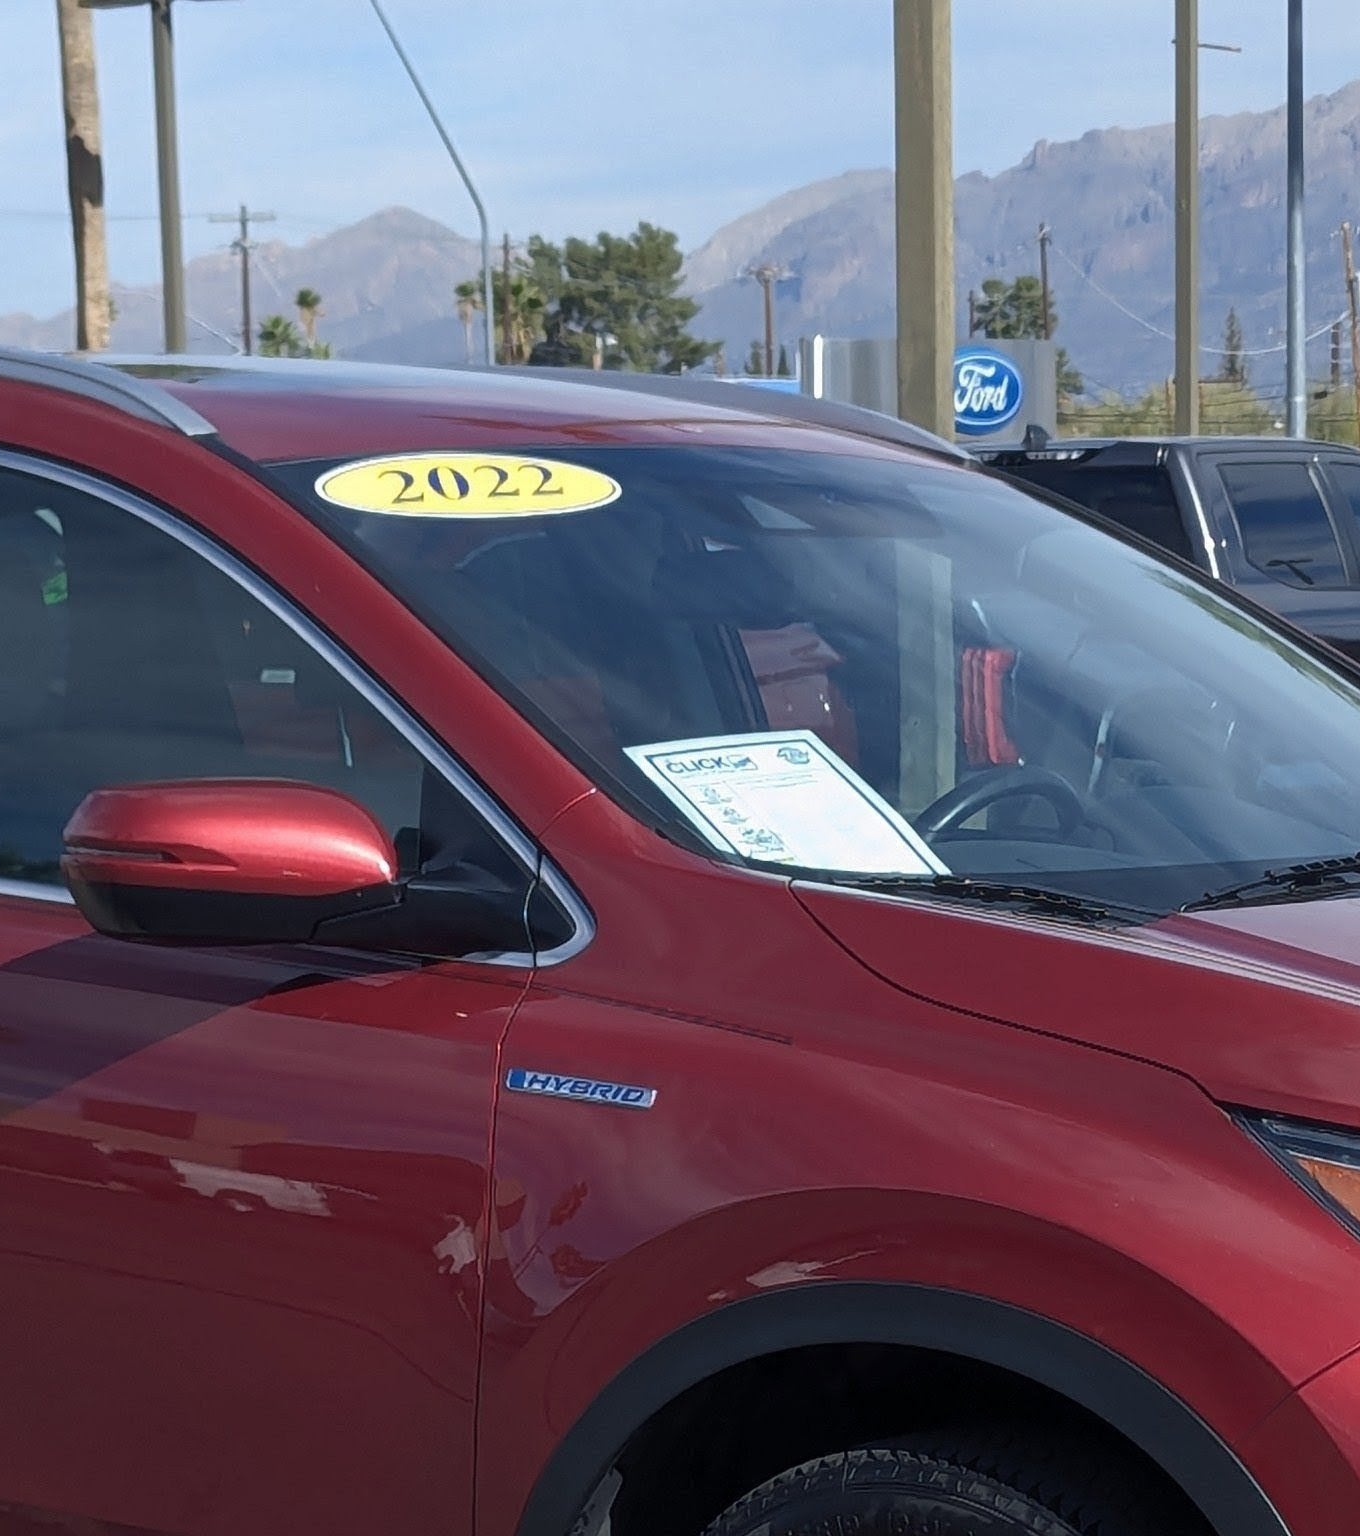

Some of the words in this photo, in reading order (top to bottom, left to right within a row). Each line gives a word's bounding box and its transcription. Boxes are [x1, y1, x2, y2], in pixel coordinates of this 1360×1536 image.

[954, 364, 1009, 413] Ford
[377, 464, 564, 504] 2022
[665, 755, 730, 775] CLICK
[527, 1074, 644, 1102] HYBRID
